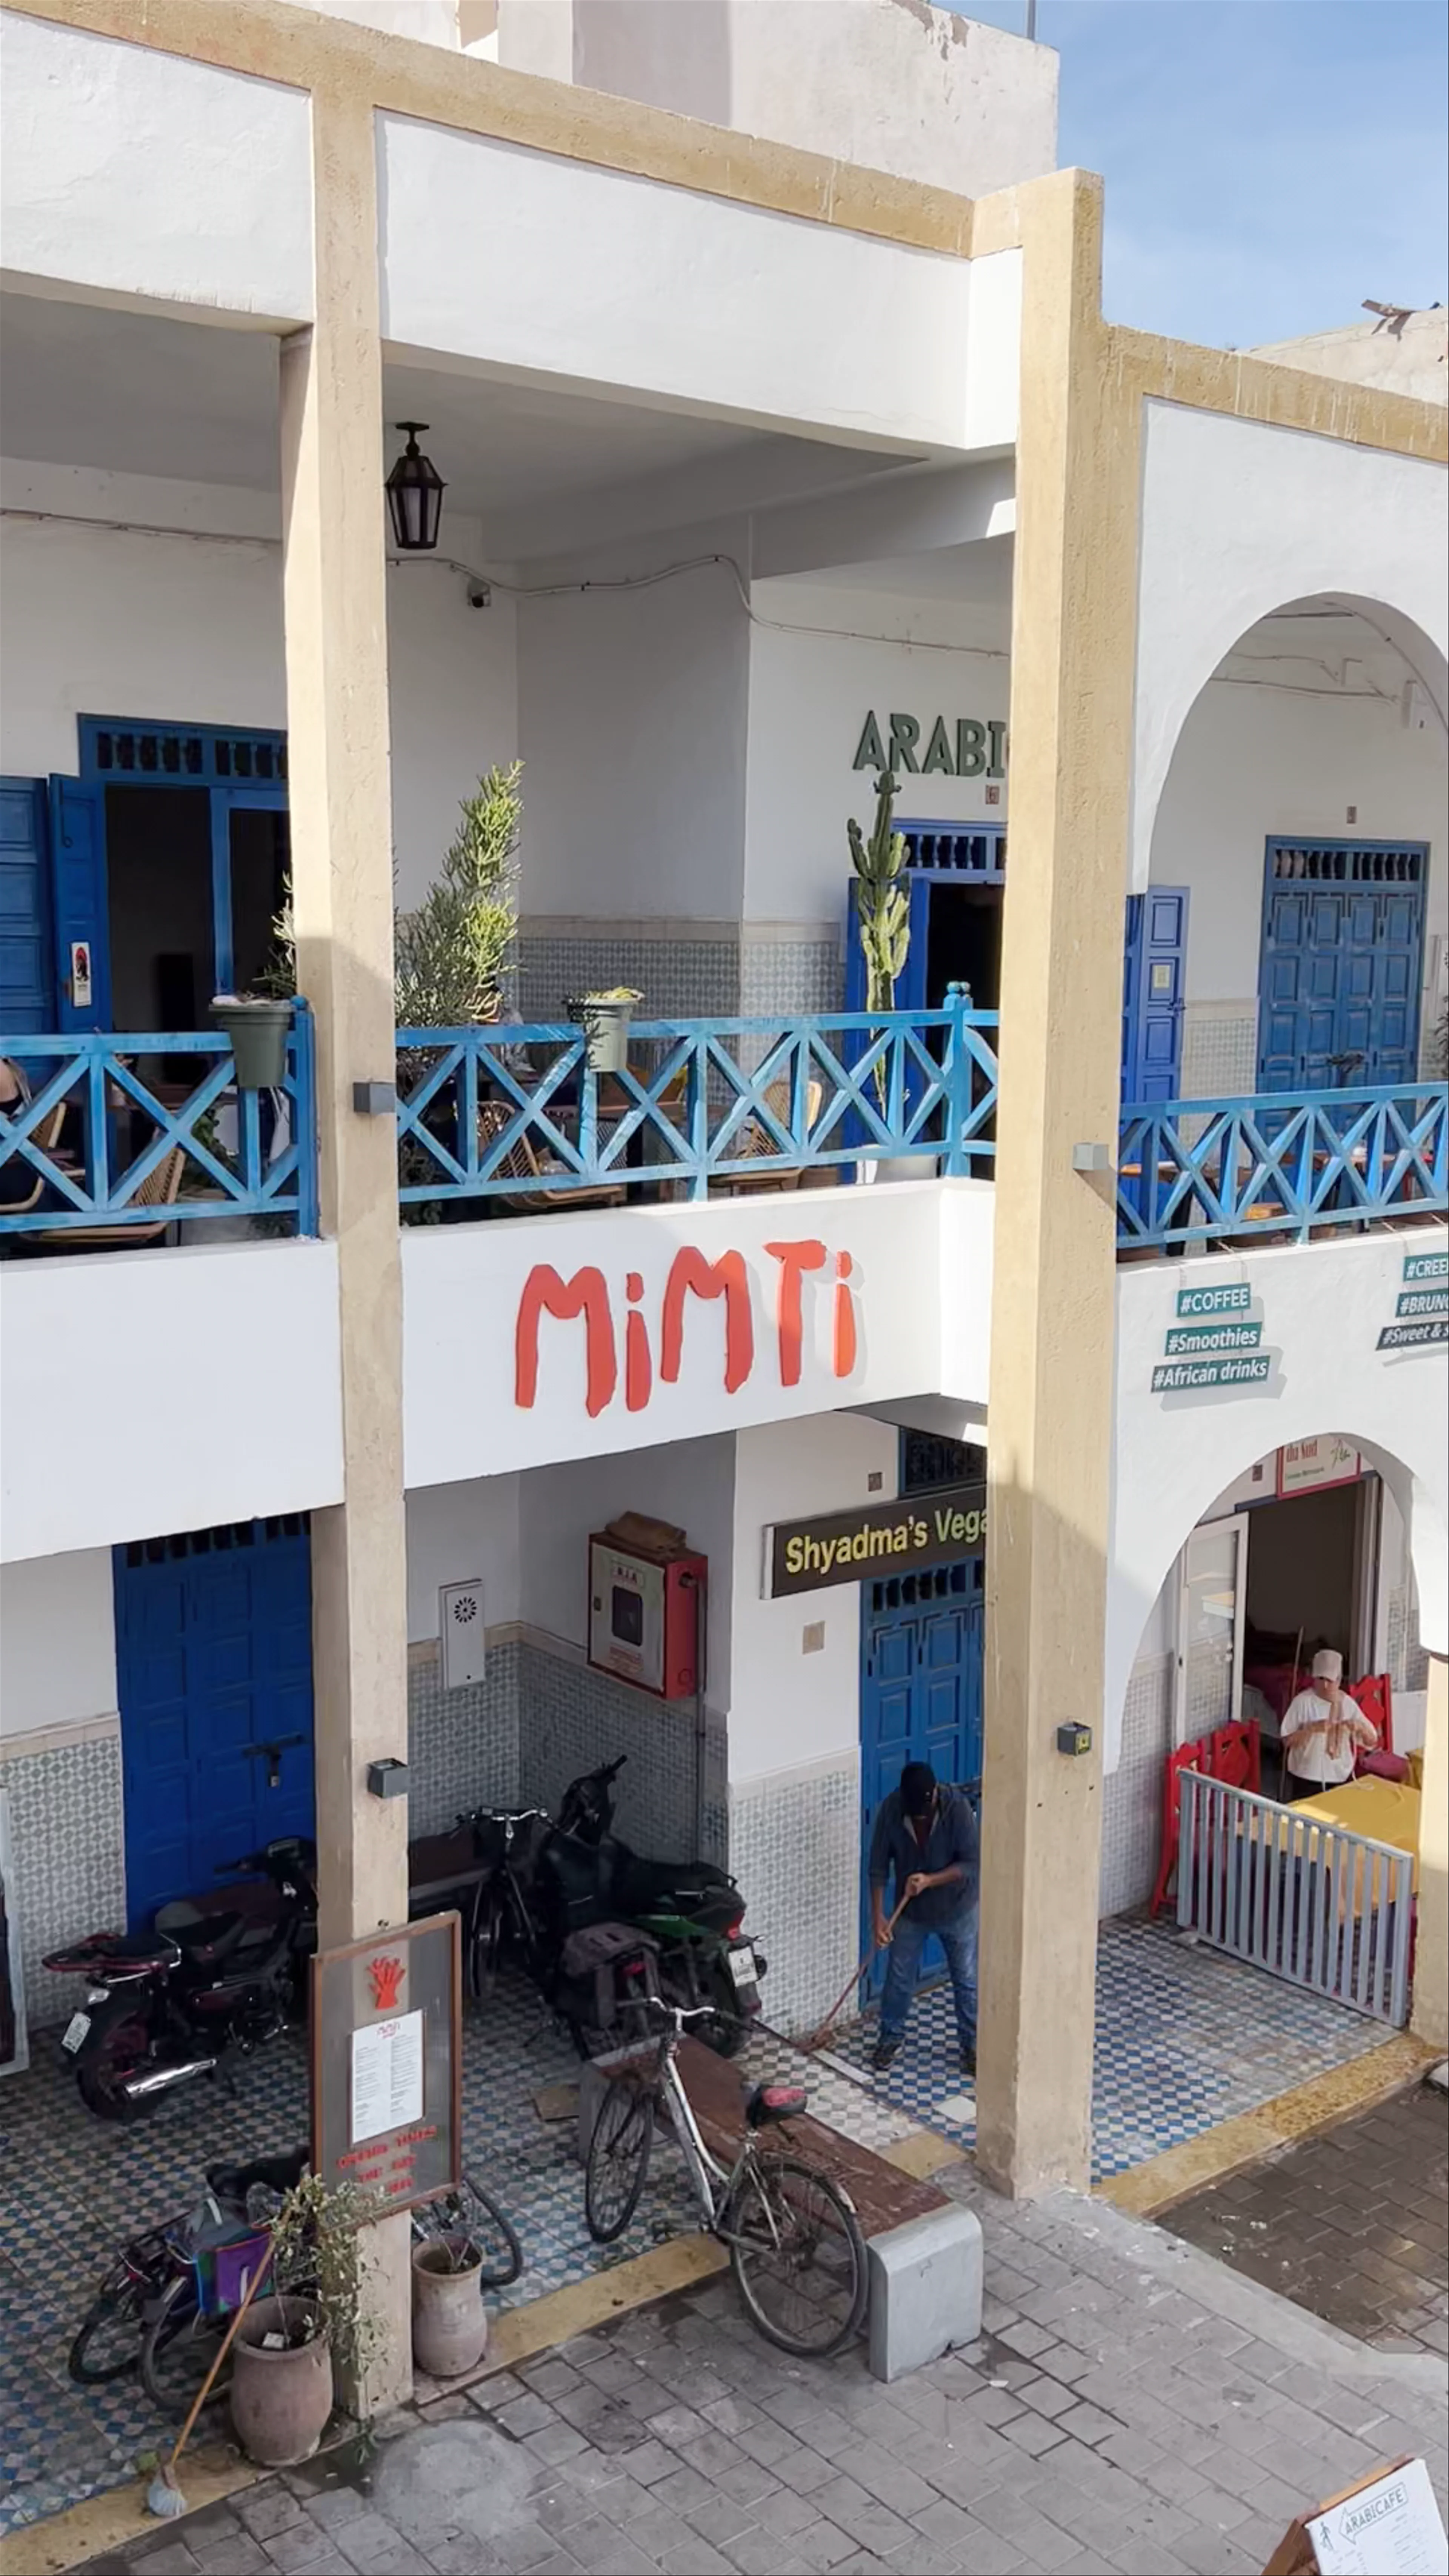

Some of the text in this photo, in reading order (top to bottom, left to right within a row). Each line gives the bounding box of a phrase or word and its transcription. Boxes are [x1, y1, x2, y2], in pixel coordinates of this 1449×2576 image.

[852, 710, 1010, 778] ARABI
[1406, 1258, 1448, 1278] #CREE
[1180, 1288, 1248, 1313] #COFFEE
[1400, 1293, 1448, 1314] #BRUN
[1168, 1327, 1257, 1353] #Smoothies
[1383, 1324, 1430, 1344] #Sweet
[1431, 1323, 1441, 1338] &
[1154, 1359, 1267, 1388] #African drinks
[786, 1516, 928, 1573] Shyadma's
[1345, 2488, 1404, 2534] ARABICAFE
